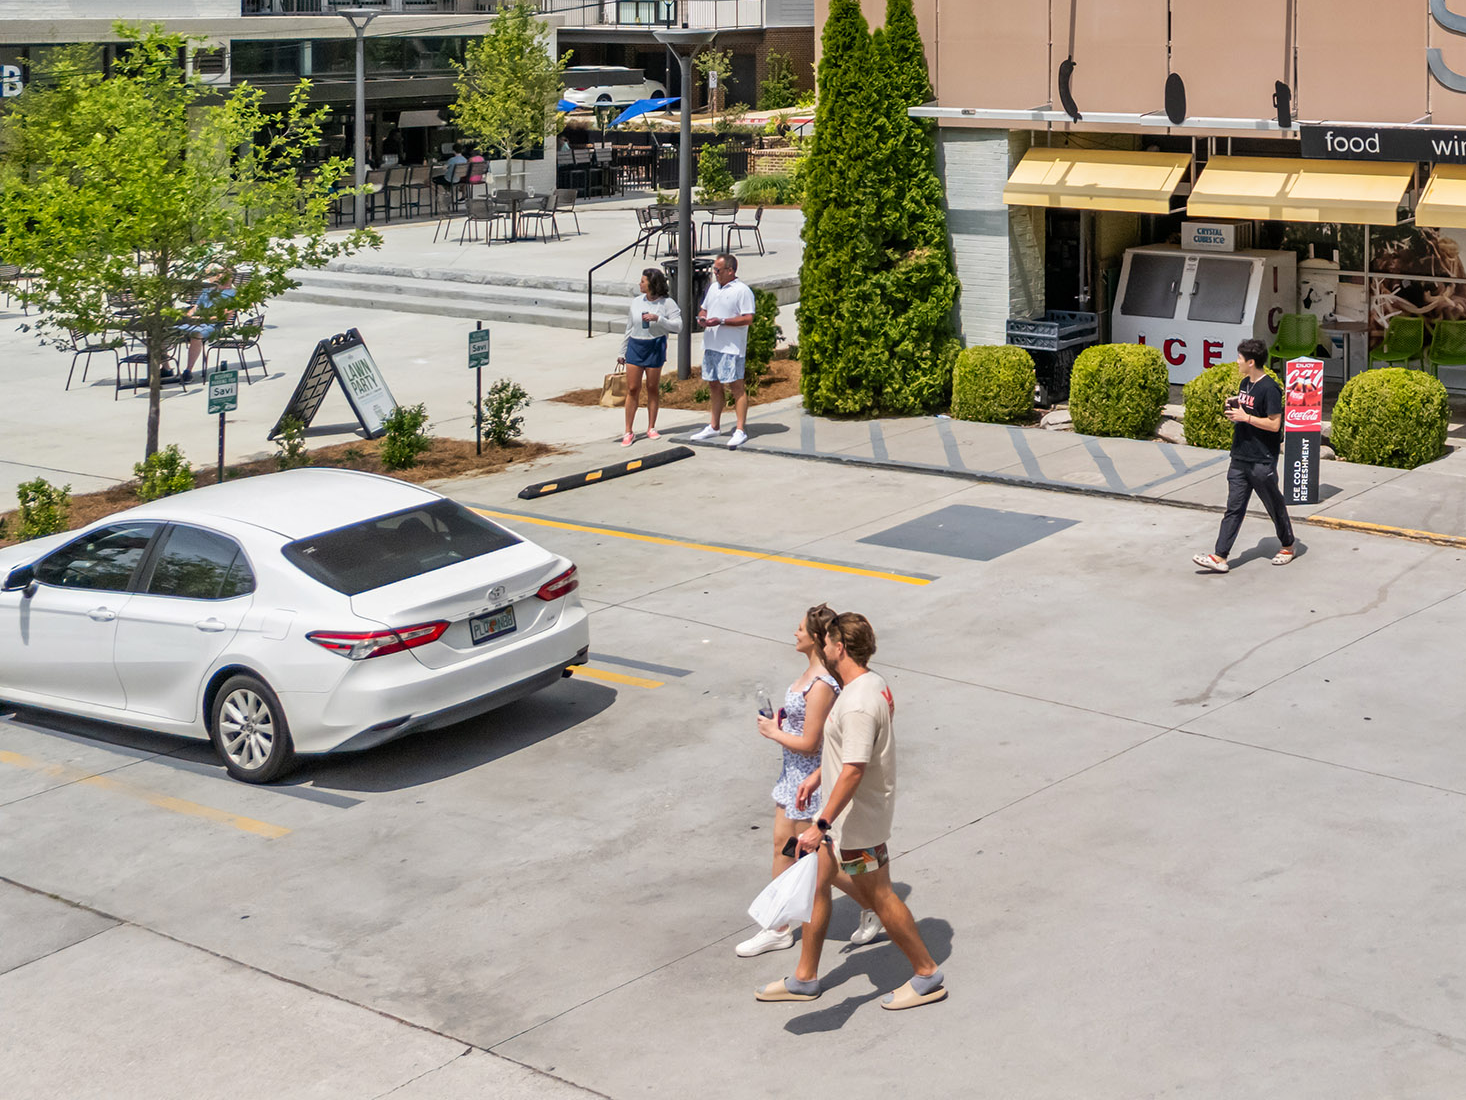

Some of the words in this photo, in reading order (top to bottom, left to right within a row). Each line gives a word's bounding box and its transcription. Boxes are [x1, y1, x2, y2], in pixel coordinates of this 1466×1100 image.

[1324, 131, 1381, 154] food
[1196, 228, 1223, 236] CRYSTAL
[343, 358, 373, 382] LAWN
[214, 385, 233, 396] Savi
[350, 373, 378, 397] PARTY
[1293, 460, 1301, 485] COLD
[1301, 438, 1310, 501] REFRESHMENT
